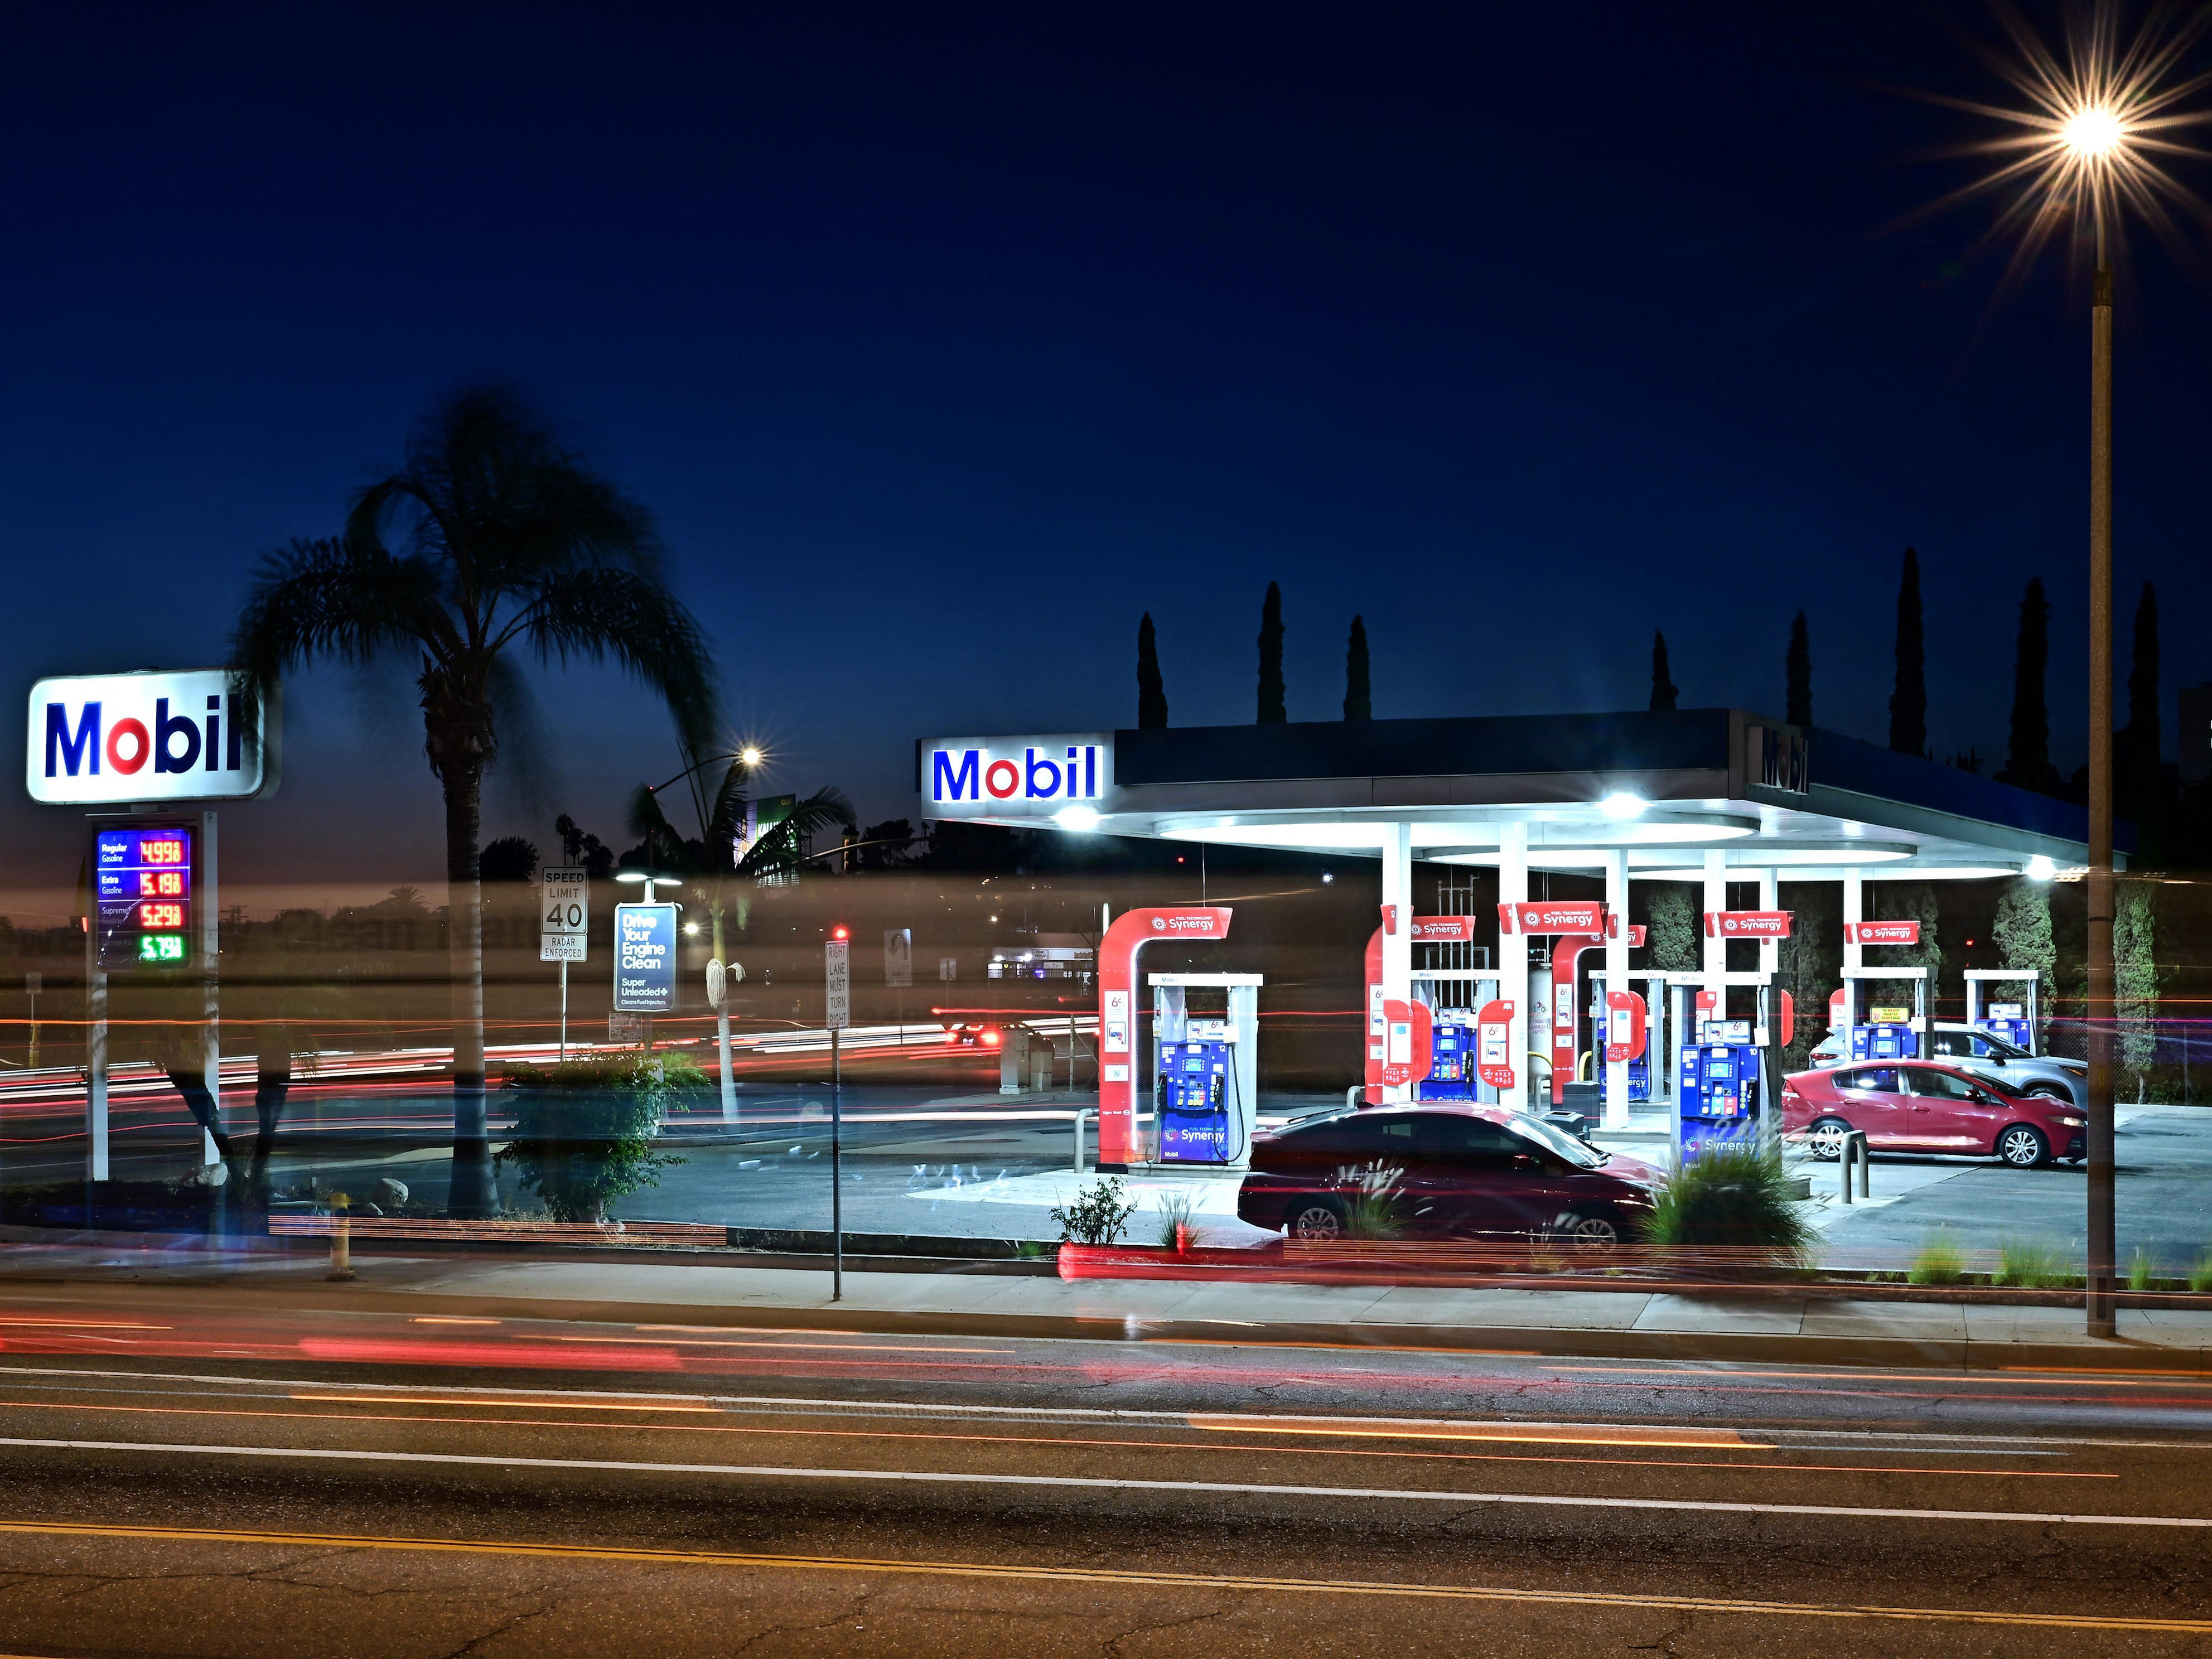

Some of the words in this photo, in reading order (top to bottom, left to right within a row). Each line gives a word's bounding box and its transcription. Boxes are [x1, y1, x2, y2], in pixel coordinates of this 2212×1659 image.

[45, 694, 242, 777] Mobil
[933, 746, 1099, 801] Mobil
[102, 844, 127, 854] Regular
[102, 876, 119, 884] Extra
[545, 873, 584, 883] SPEED
[549, 888, 579, 898] LIMIT
[547, 903, 582, 927] 40
[622, 914, 657, 928] Drive
[1543, 913, 1593, 926] Synergy
[1168, 918, 1214, 931] Synergy
[1424, 925, 1462, 935] Synergy
[1740, 921, 1781, 931] Synergy
[622, 928, 651, 941] Your
[1875, 929, 1911, 938] Synergy
[552, 937, 575, 946] RADAR
[545, 949, 582, 957] ENFORCED
[622, 942, 666, 958] Engine
[828, 945, 846, 959] RIGHT
[622, 956, 661, 969] Clean
[829, 962, 846, 975] LANE
[622, 978, 646, 989] Super
[829, 979, 846, 992] MUST
[830, 997, 846, 1009] TURN
[829, 1013, 847, 1026] RIGHT
[1181, 1129, 1225, 1143] Synergy
